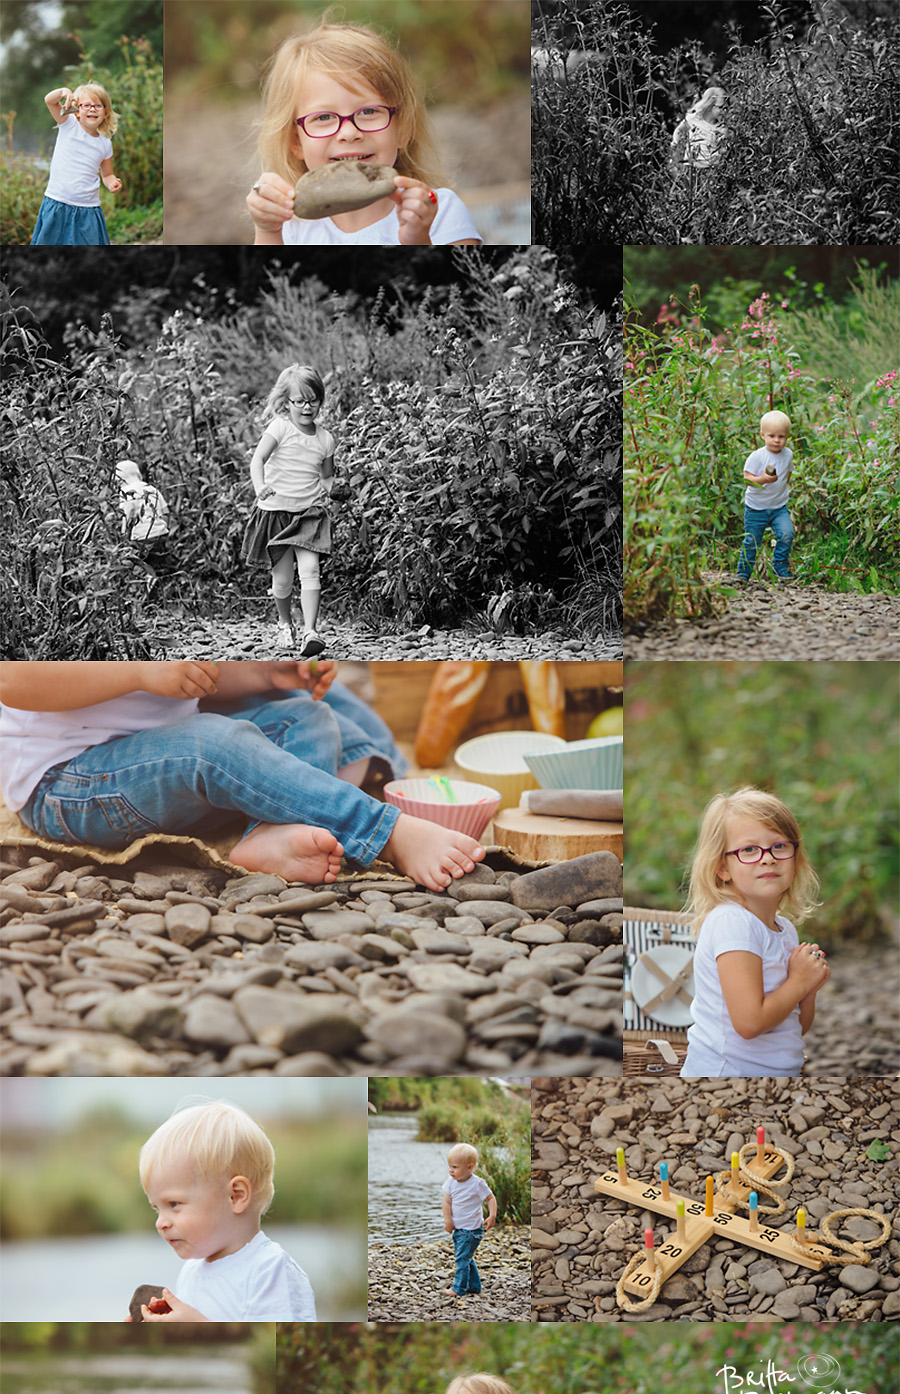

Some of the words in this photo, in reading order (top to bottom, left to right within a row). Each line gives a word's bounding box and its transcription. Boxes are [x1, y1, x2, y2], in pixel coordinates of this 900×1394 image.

[603, 1175, 618, 1184] 5
[642, 1188, 661, 1200] 25
[686, 1203, 705, 1215] 50
[713, 1213, 733, 1225] 50
[759, 1228, 780, 1242] 25
[660, 1244, 682, 1258] 20
[632, 1273, 651, 1286] 10
